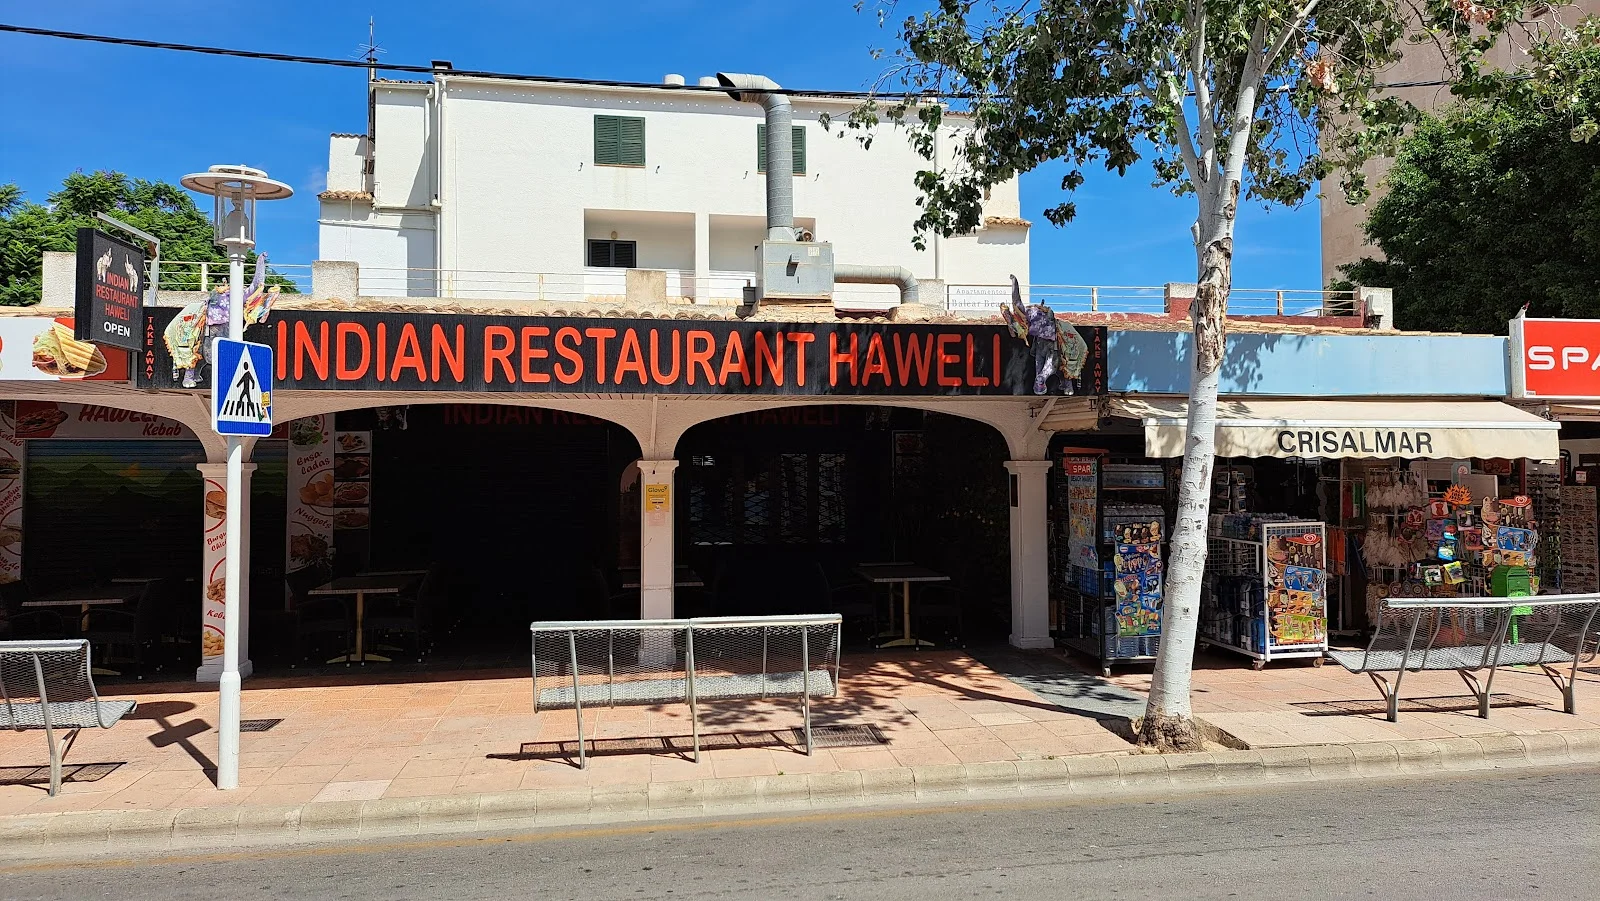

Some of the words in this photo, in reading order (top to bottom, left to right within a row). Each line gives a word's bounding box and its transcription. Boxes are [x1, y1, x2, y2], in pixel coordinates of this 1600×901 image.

[106, 271, 130, 291] INDIAN
[96, 284, 138, 309] RESTAURANT
[984, 299, 1011, 308] Beah
[105, 303, 130, 321] HAWELI
[103, 321, 131, 338] OPEN
[147, 316, 155, 346] TAKE
[276, 320, 465, 382] INDIAN
[484, 325, 815, 387] RESTAURANT
[829, 331, 1001, 387] HAWELI
[145, 350, 155, 380] AWAY
[1093, 363, 1102, 393] AWAY
[142, 416, 182, 436] Kebab
[1277, 430, 1433, 454] CRISALMAR
[1072, 465, 1091, 473] SPAR
